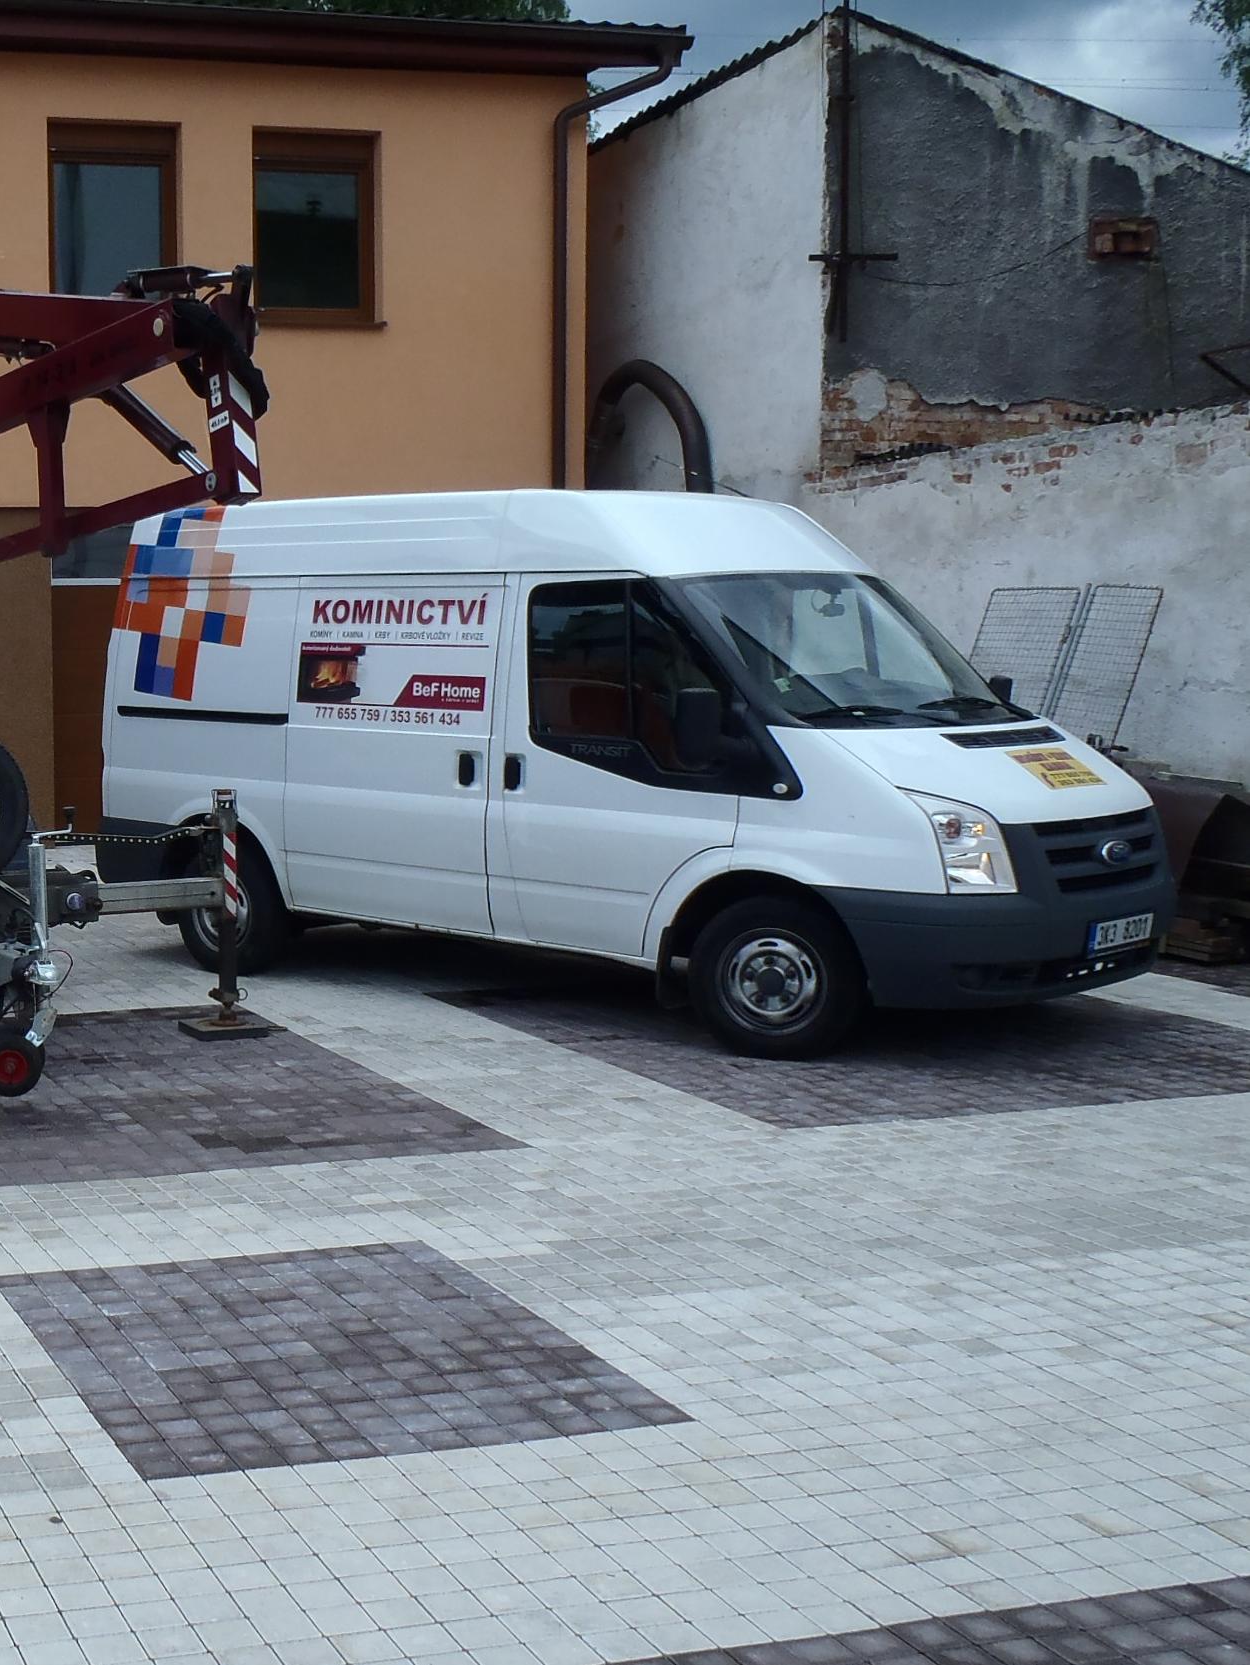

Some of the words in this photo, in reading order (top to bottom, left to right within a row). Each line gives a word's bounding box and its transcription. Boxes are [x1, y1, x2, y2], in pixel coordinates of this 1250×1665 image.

[312, 593, 489, 626] KOMINICTVÍ
[461, 632, 485, 641] REVIZE
[440, 682, 481, 698] Home
[315, 706, 334, 719] 777
[337, 707, 357, 720] 655
[360, 708, 380, 722] 759
[390, 710, 411, 724] 353
[414, 711, 435, 725] 561
[438, 713, 461, 726] 434
[570, 743, 633, 757] TRANSIT
